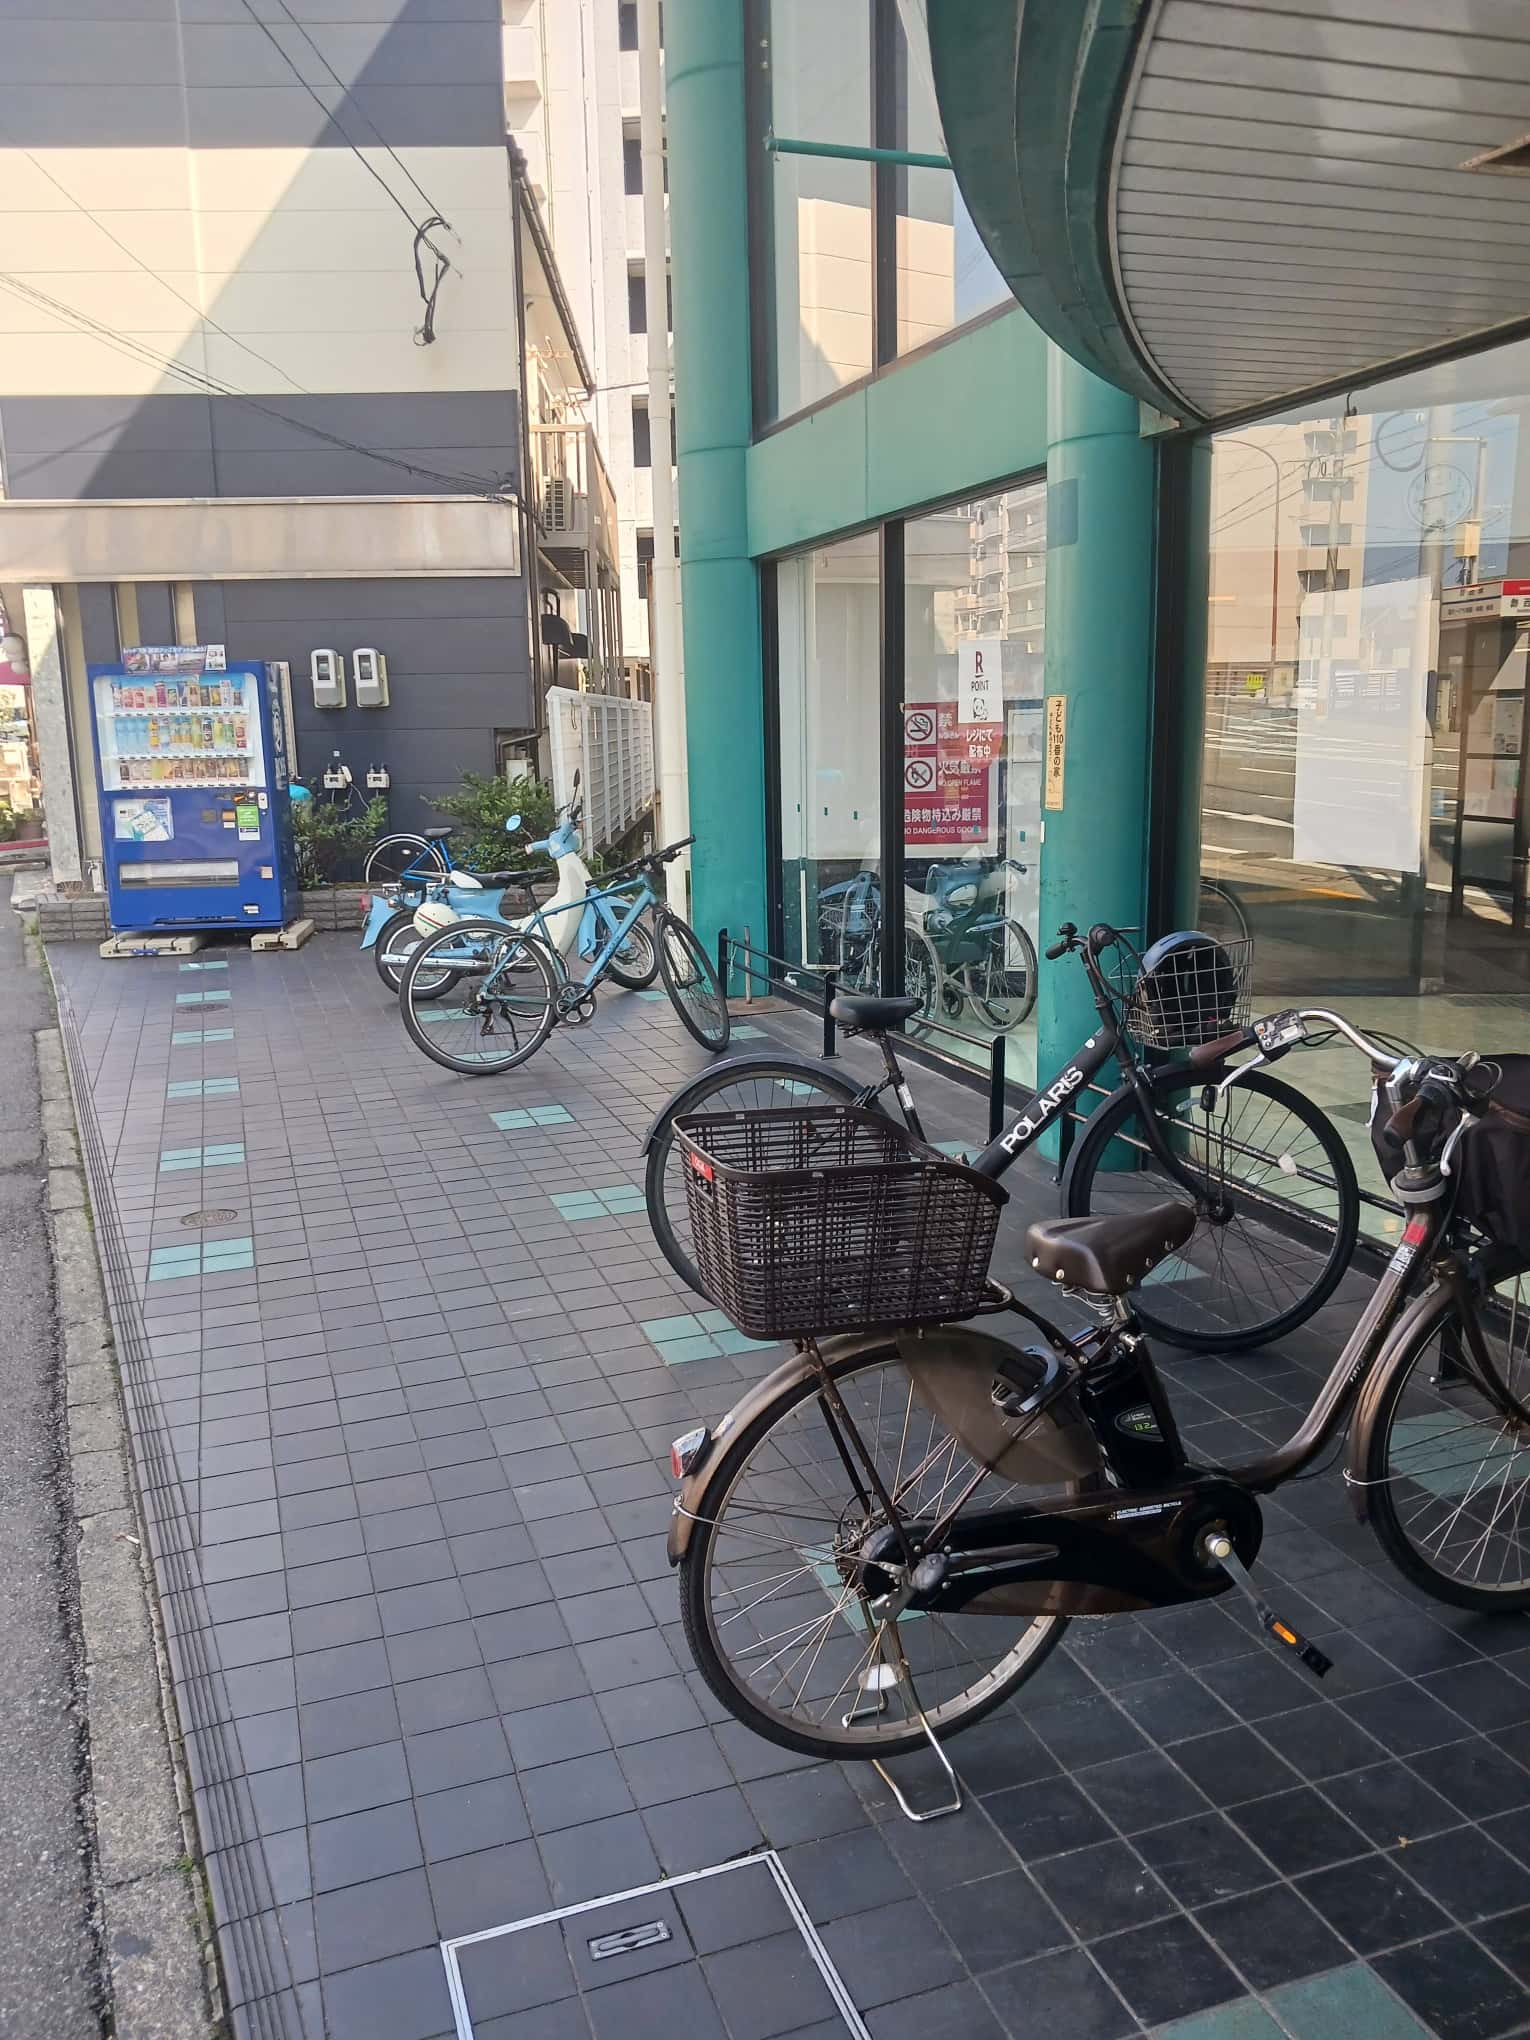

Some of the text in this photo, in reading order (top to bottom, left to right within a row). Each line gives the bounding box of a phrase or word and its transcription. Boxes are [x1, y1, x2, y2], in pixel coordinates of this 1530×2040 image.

[975, 650, 984, 674] R
[971, 680, 989, 692] POINT
[966, 728, 994, 742] レジにて
[1000, 1066, 1084, 1154] POLARIS
